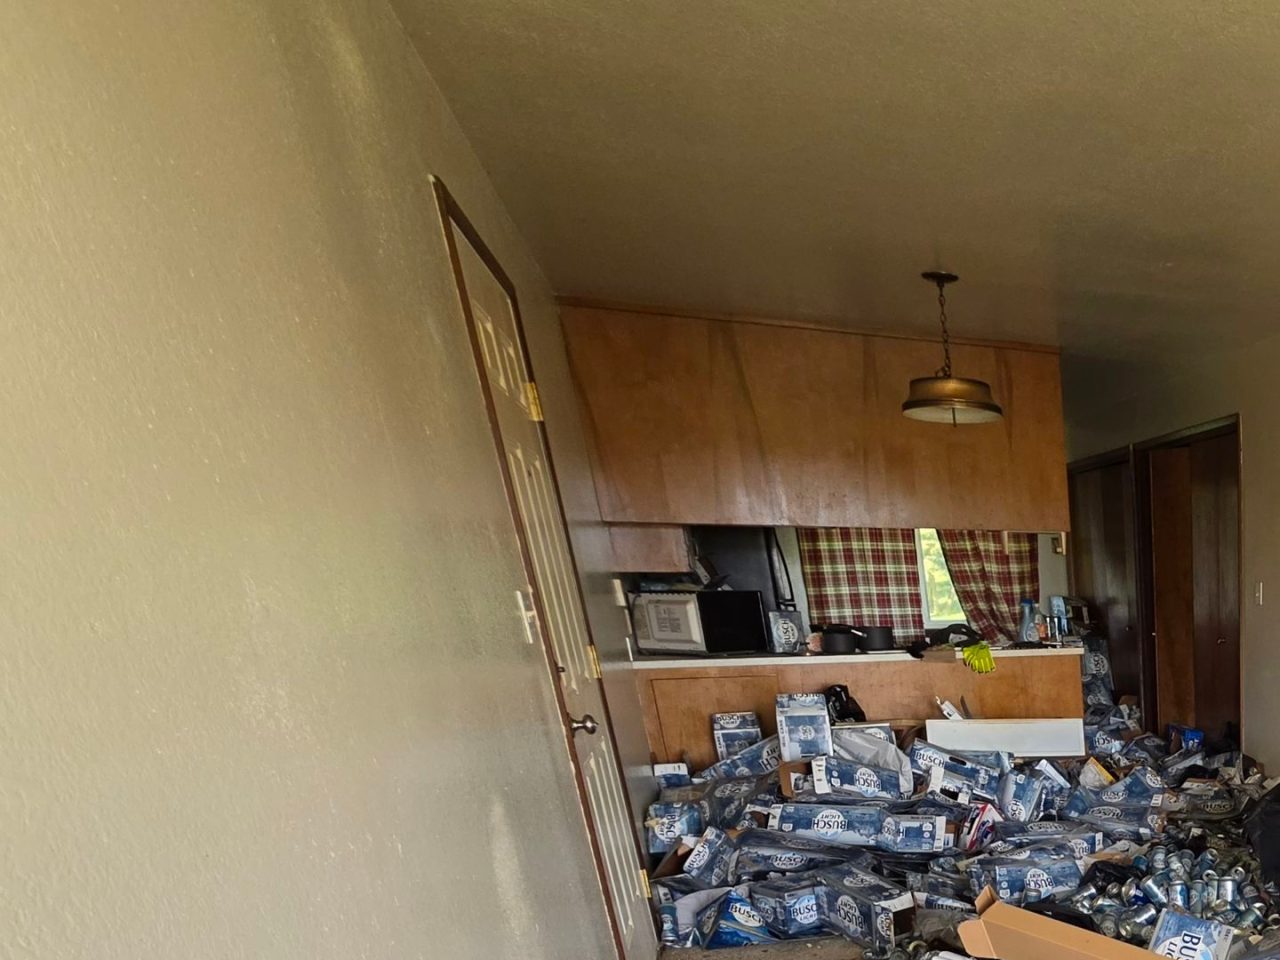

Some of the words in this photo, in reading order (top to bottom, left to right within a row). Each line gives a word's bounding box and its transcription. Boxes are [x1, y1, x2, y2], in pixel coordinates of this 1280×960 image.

[784, 618, 792, 646] BUSCH
[914, 750, 946, 768] BUSCH
[855, 773, 881, 789] BUSCH
[812, 818, 848, 830] BUSCH
[791, 903, 818, 919] BUSC
